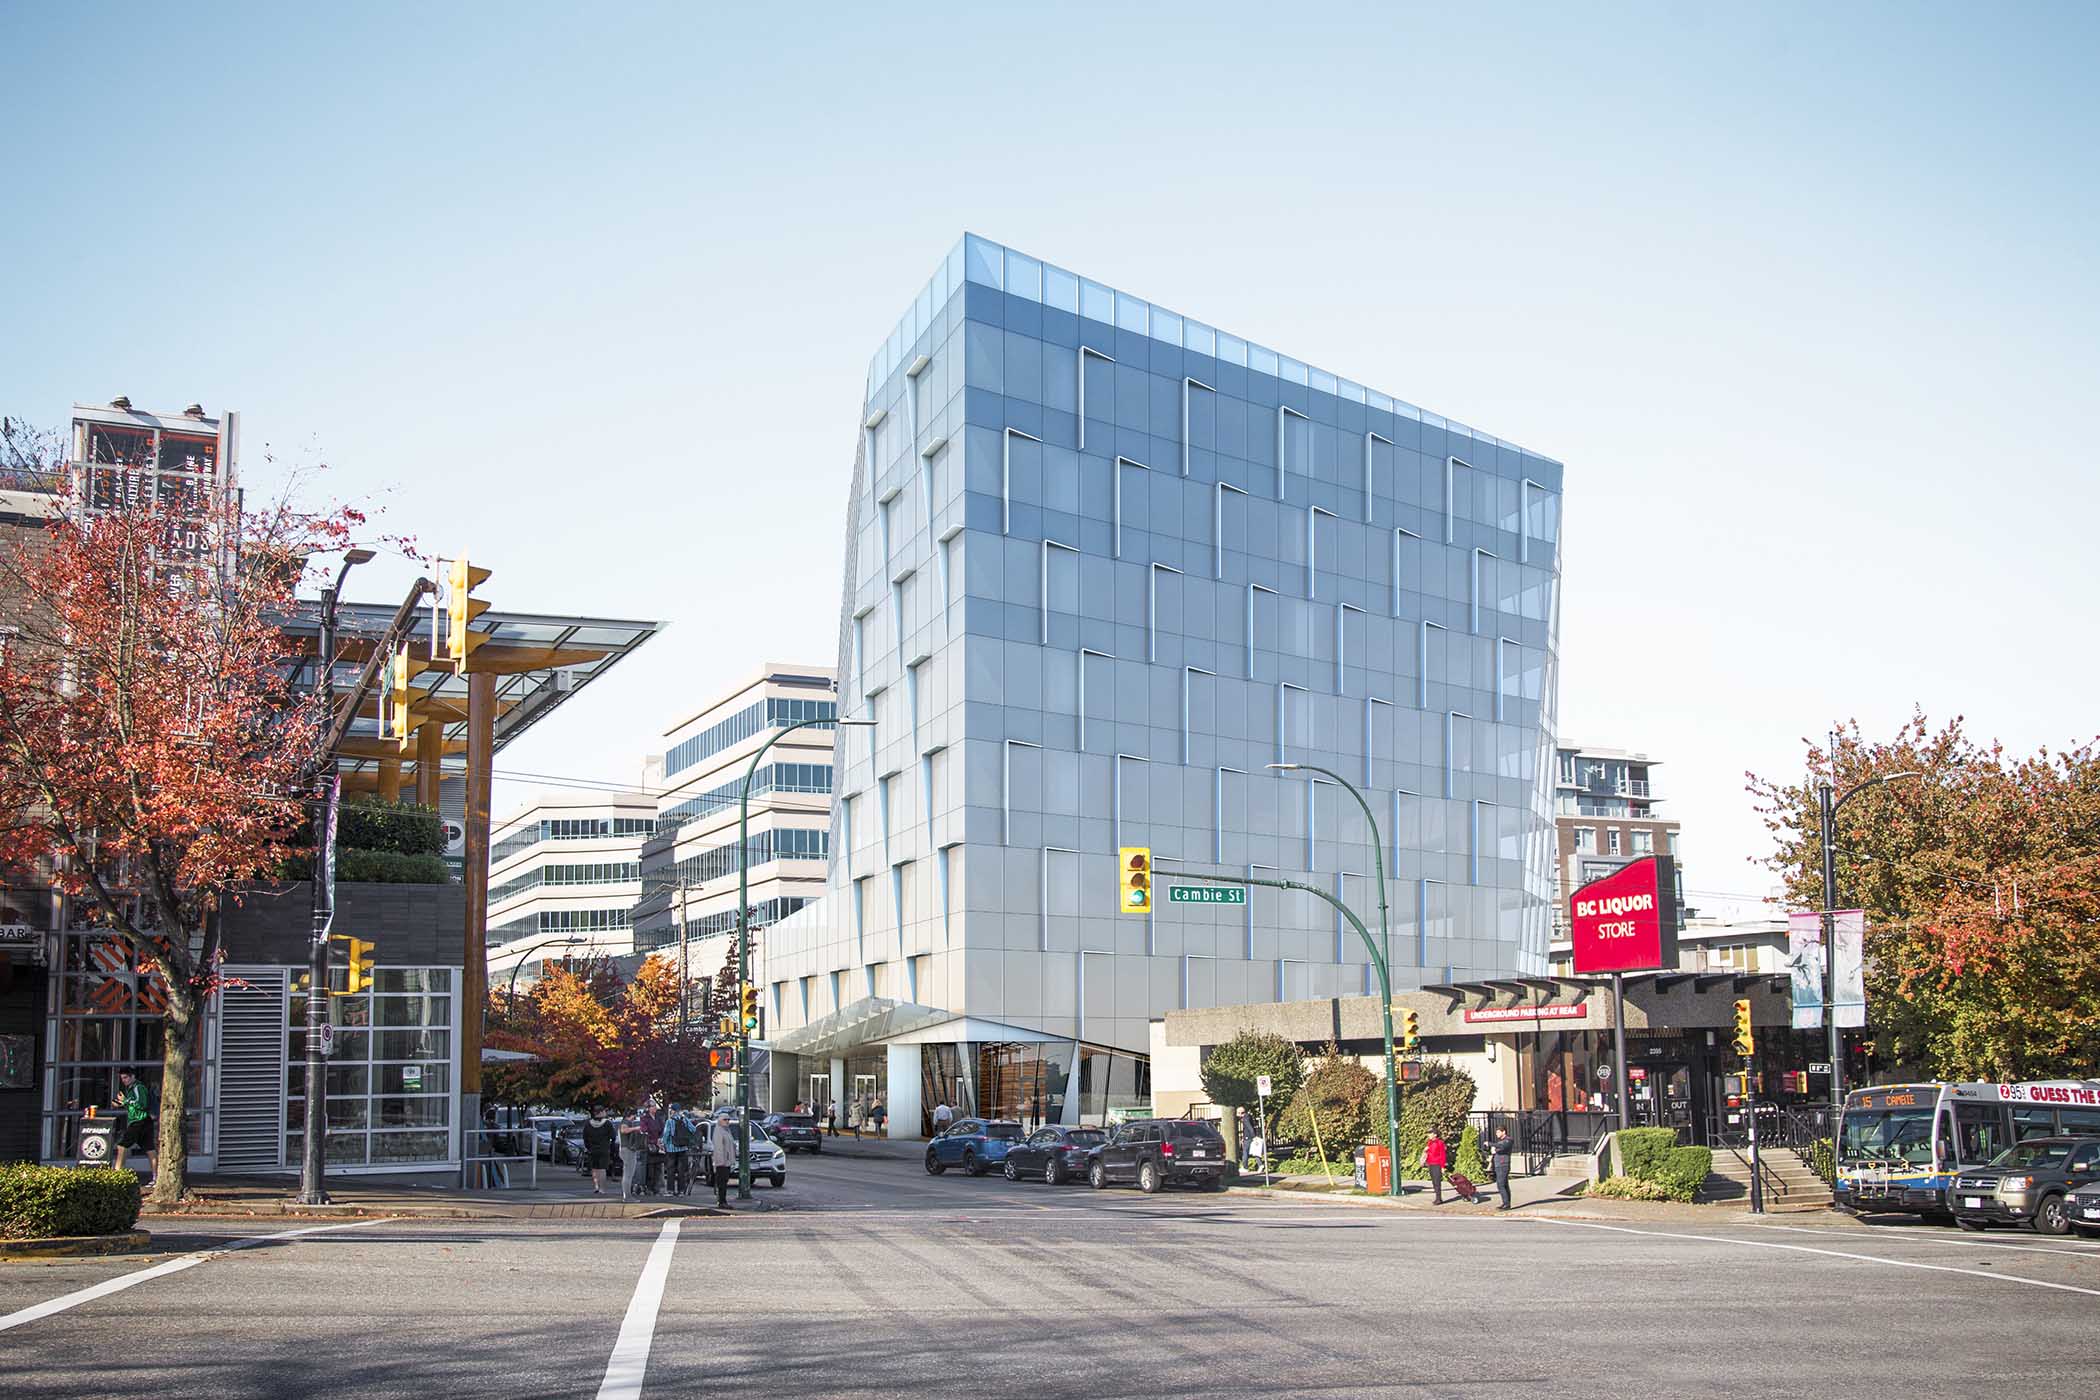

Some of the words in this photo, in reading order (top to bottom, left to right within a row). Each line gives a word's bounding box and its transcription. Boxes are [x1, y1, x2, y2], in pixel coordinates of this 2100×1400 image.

[203, 458, 213, 495] BROADWAY
[1174, 888, 1223, 901] Cambie
[1228, 889, 1241, 902] St
[1576, 900, 1597, 917] BC
[1598, 894, 1654, 916] LIQUOR
[1598, 921, 1636, 939] STORE
[1470, 1009, 1520, 1020] UNDERGROUND
[1520, 1007, 1549, 1018] PARKING
[1549, 1007, 1559, 1015] AT
[1559, 1006, 1578, 1015] REAR
[1862, 1096, 1873, 1109] 15
[1885, 1094, 1915, 1106] CAMBIE
[2030, 1086, 2070, 1102] GUESS
[2071, 1088, 2096, 1104] THE
[1671, 1101, 1688, 1109] OUT
